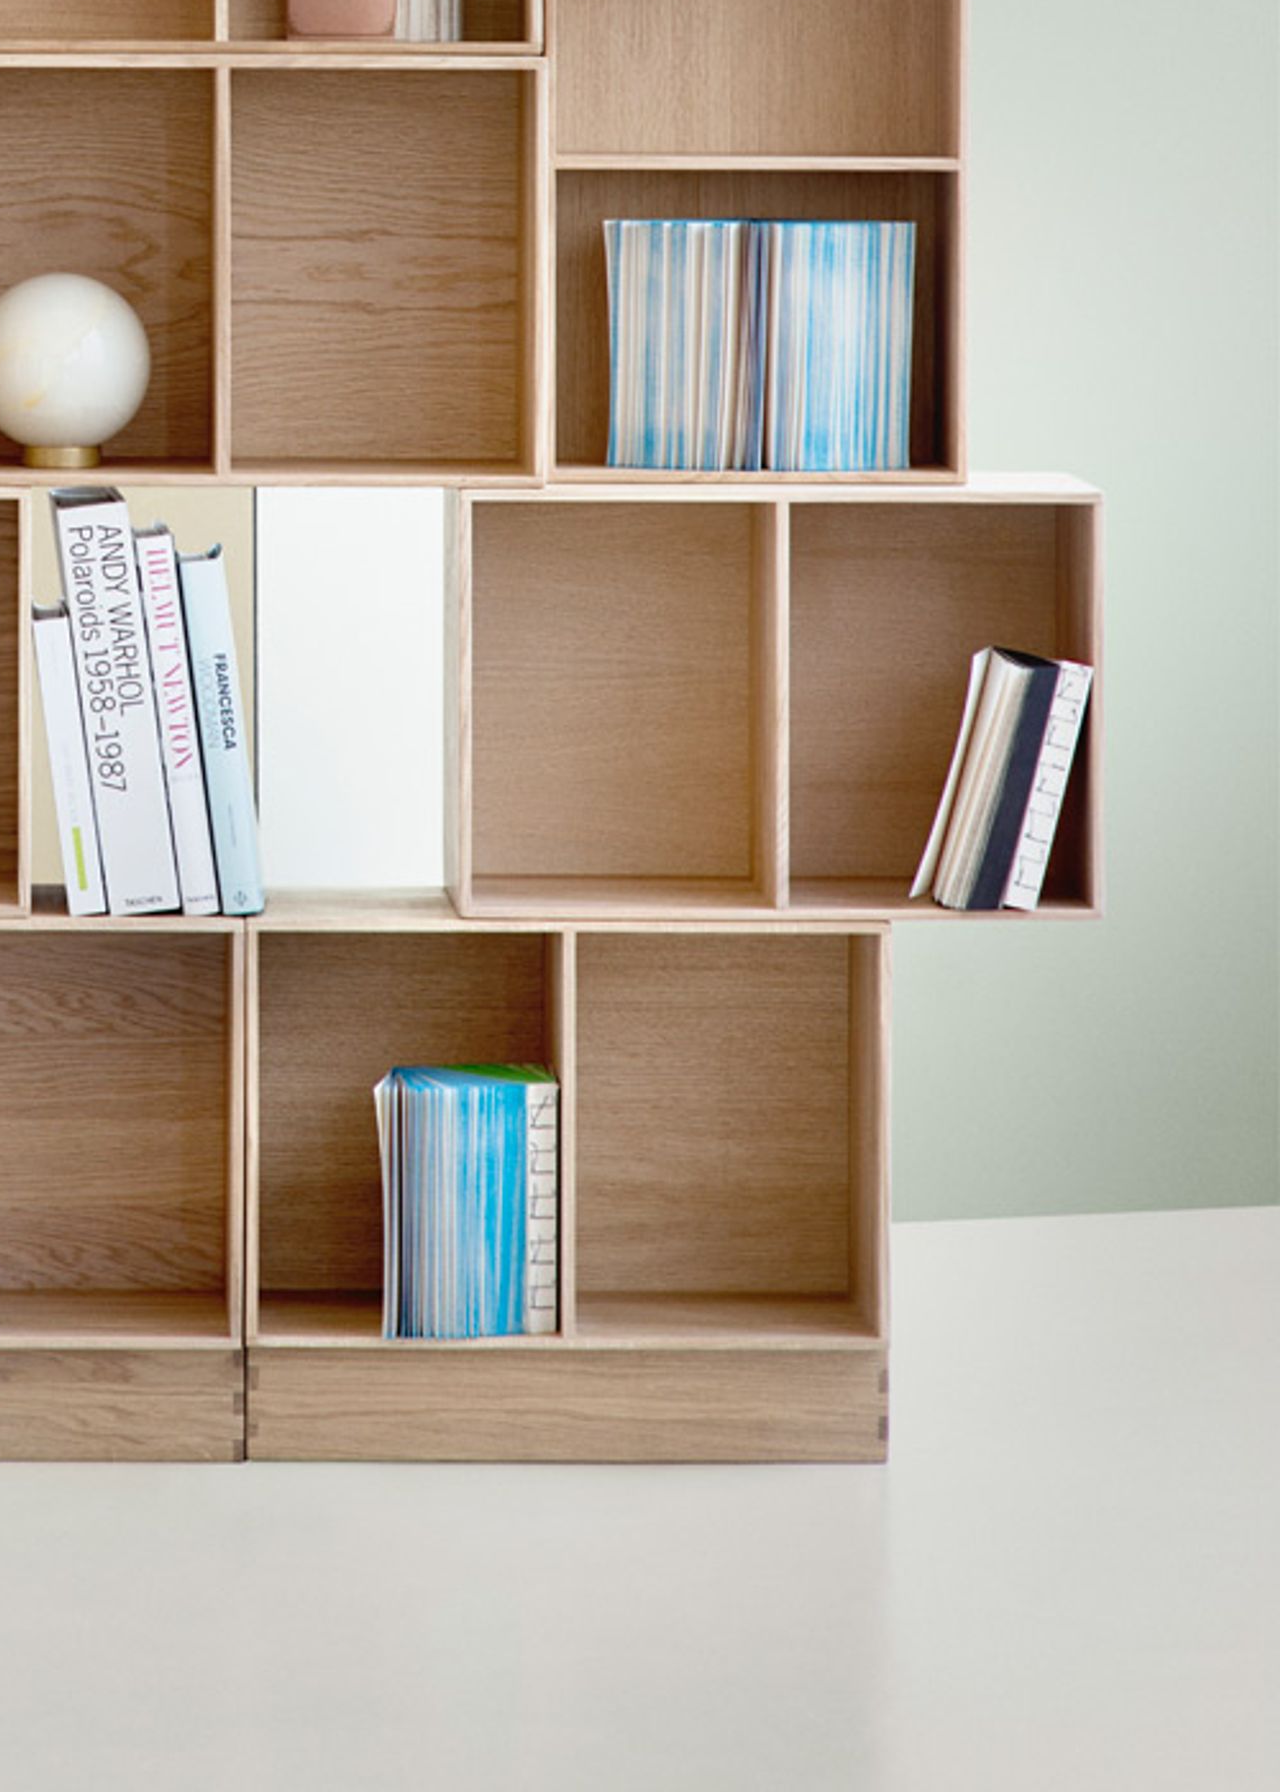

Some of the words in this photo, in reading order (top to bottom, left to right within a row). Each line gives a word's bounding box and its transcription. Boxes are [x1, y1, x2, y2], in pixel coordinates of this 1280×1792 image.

[68, 525, 105, 642] Polaroids
[96, 525, 131, 596] ANDY
[145, 549, 180, 654] HELMUT
[107, 601, 145, 717] WARHOL
[213, 652, 238, 751] FRANCESCA
[162, 662, 193, 769] NEWTON
